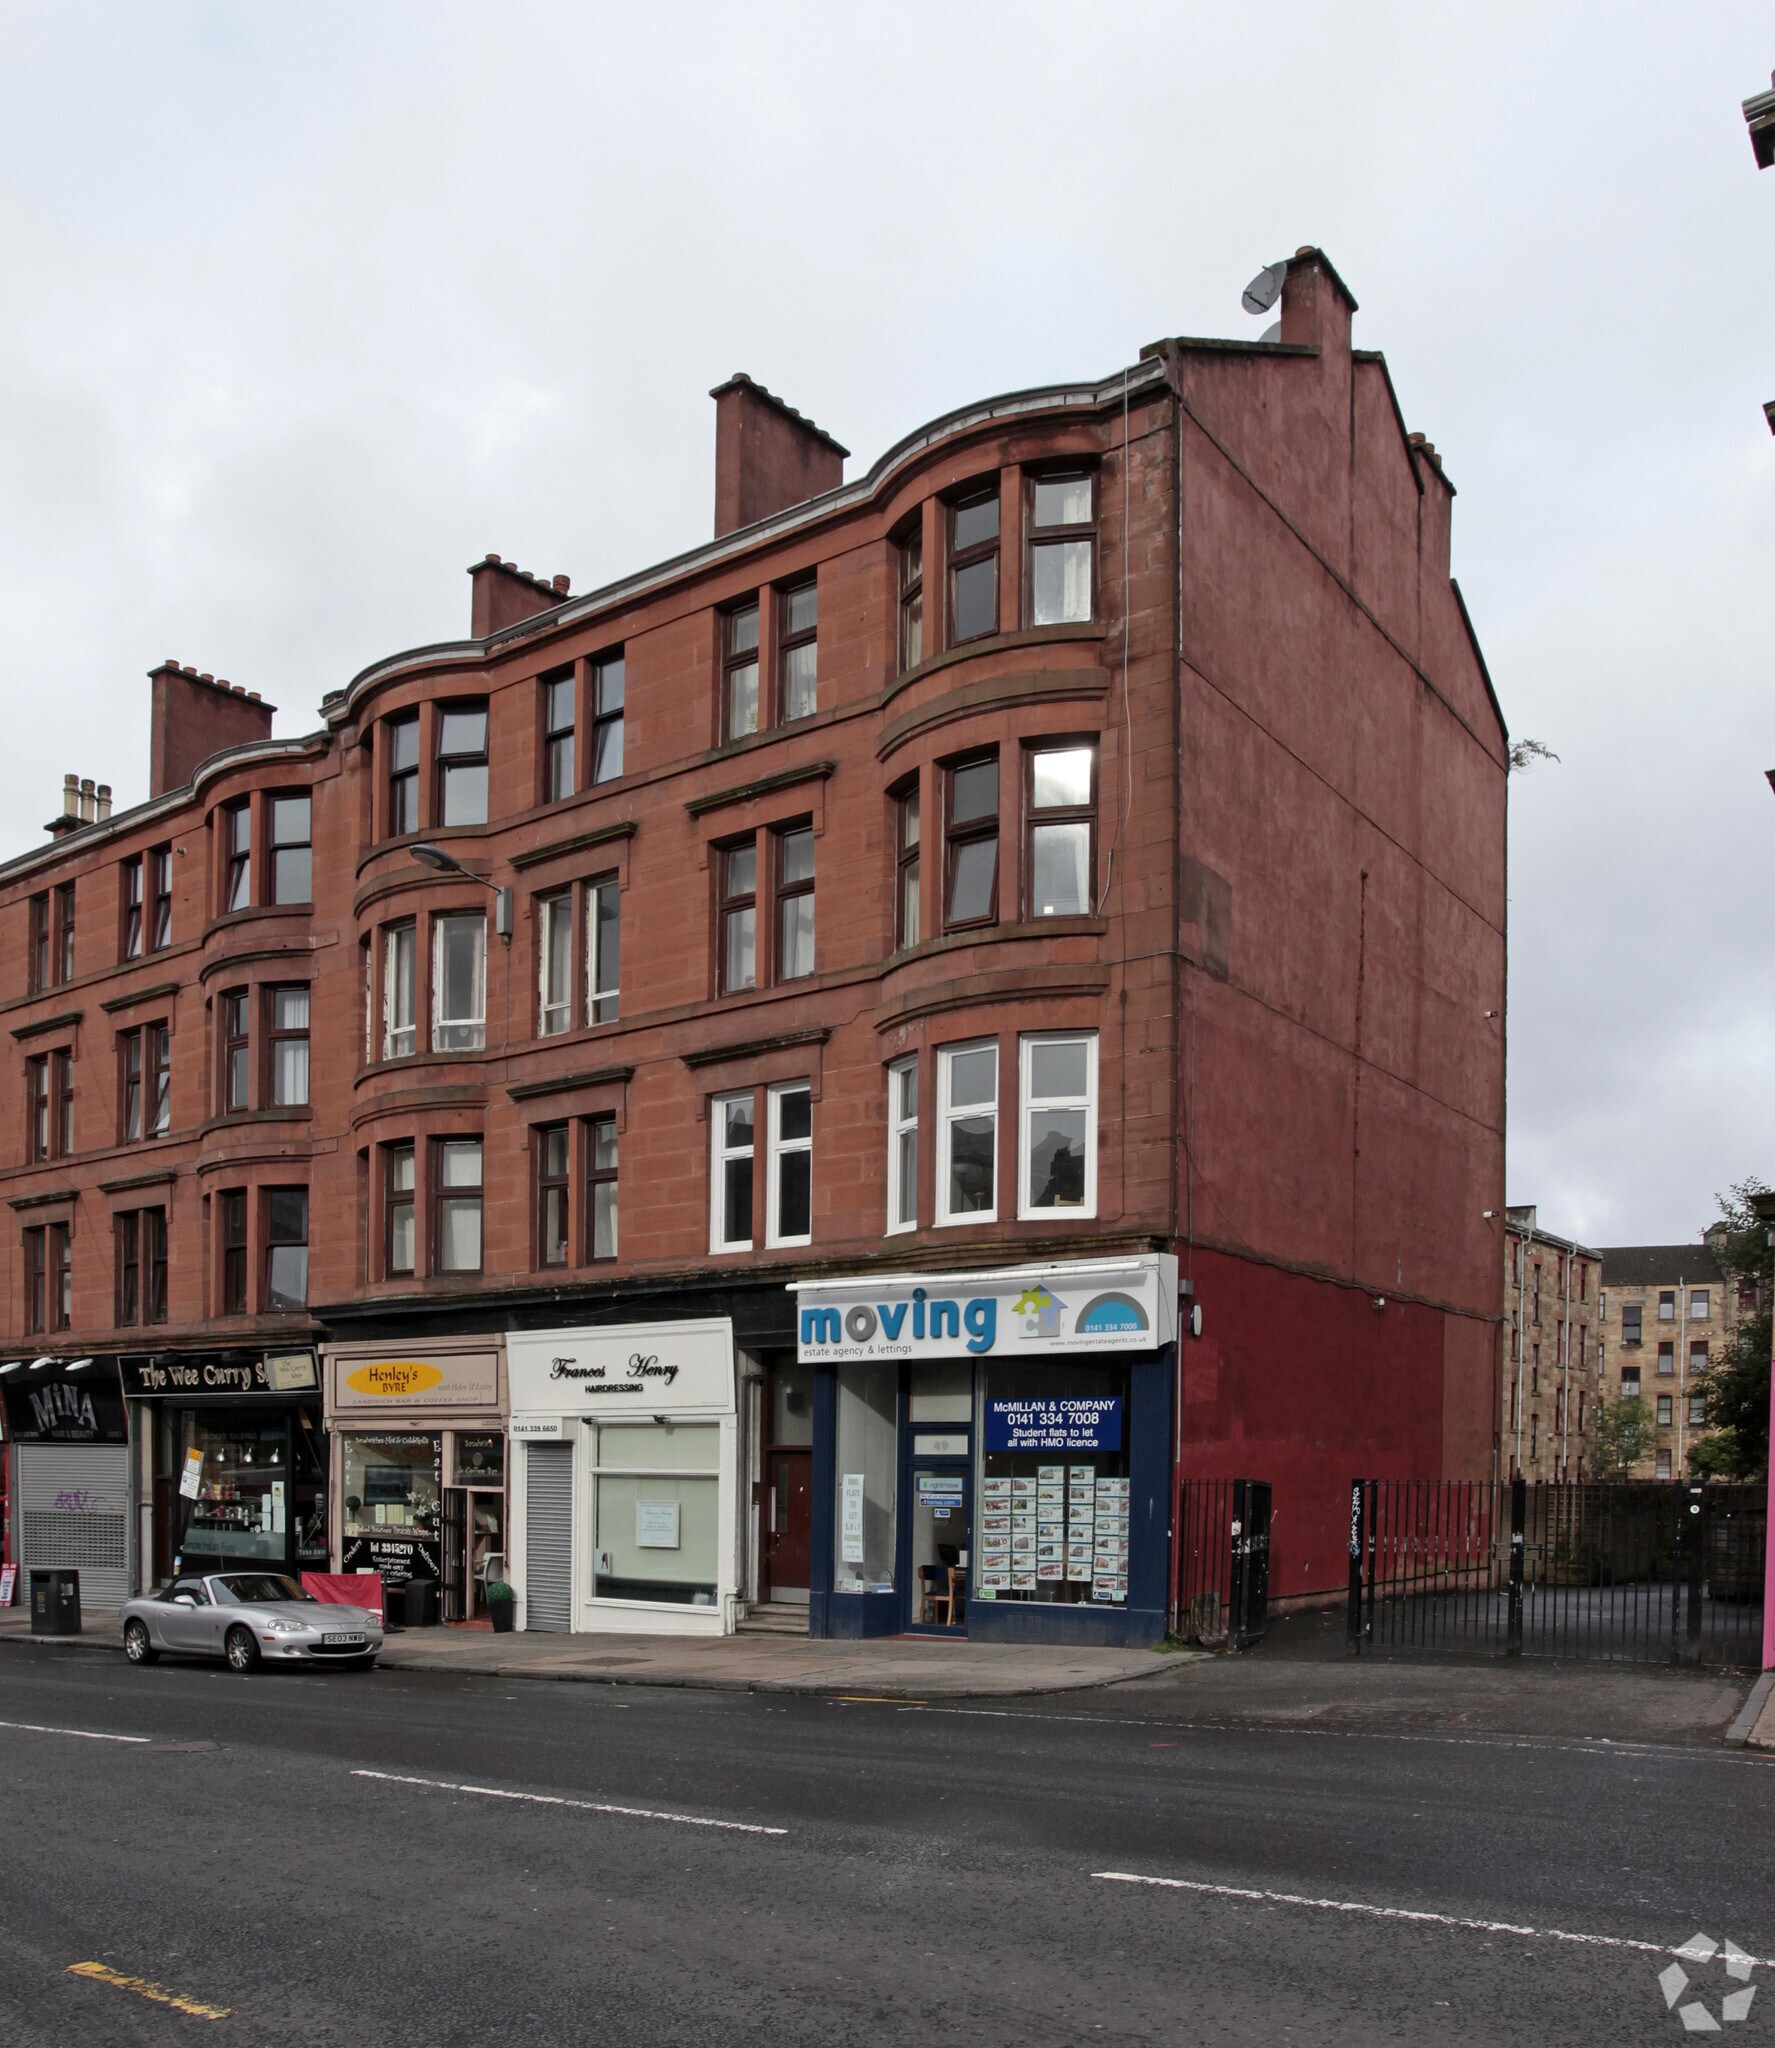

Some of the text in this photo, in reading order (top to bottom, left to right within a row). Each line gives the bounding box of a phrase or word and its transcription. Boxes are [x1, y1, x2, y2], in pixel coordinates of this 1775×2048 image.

[801, 1287, 997, 1355] moving
[1085, 1322, 1138, 1332] 0141 334 7000
[1050, 1336, 1147, 1347] www.movingestateagents.co.uk
[803, 1344, 912, 1358] estate agency & lettings
[138, 1357, 166, 1390] The
[168, 1365, 200, 1386] Wee
[203, 1364, 252, 1391] Curry
[369, 1366, 418, 1384] Henley's
[550, 1353, 679, 1386] Frances Henry
[382, 1383, 406, 1393] BYRE
[585, 1384, 644, 1393] HAIRDRESSING
[994, 1400, 1115, 1412] McMILLAN & COMPANY
[1008, 1412, 1100, 1425] 0141 334 7008
[1012, 1428, 1093, 1437] Student flats to let
[1008, 1438, 1098, 1447] all with HMO licence
[848, 1512, 857, 1520] LET
